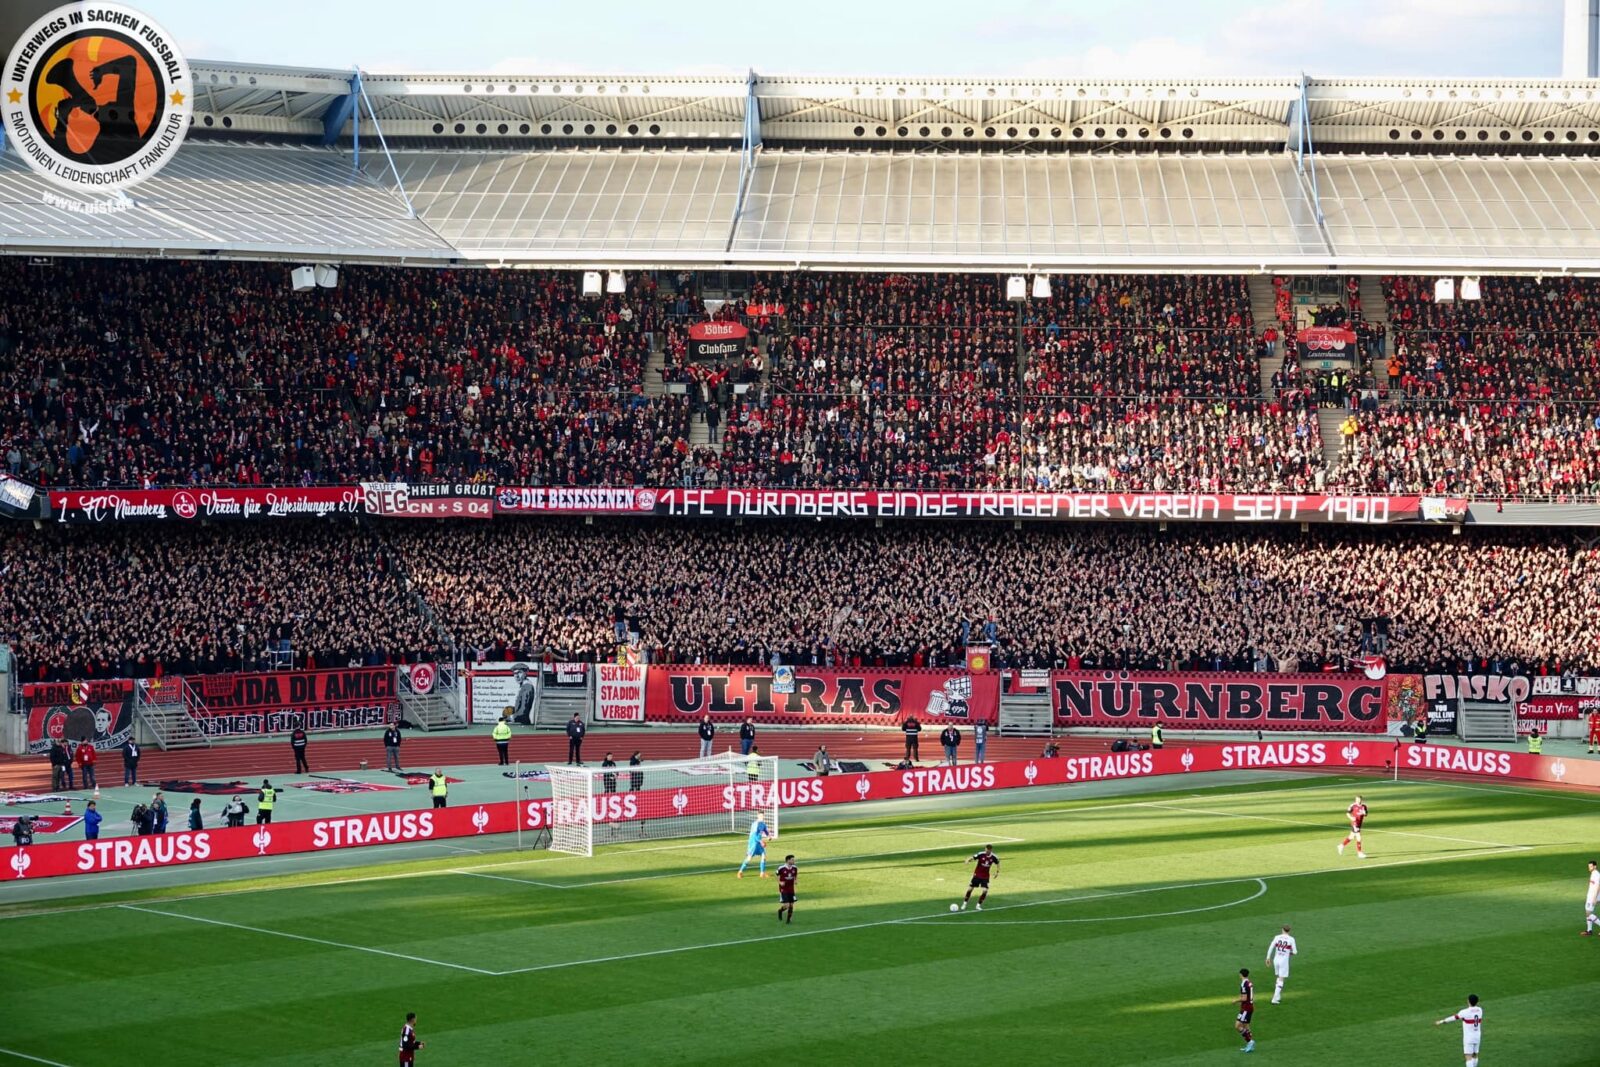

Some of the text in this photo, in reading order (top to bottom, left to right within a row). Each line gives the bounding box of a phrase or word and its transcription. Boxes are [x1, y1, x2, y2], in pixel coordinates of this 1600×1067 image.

[176, 503, 195, 513] FCN
[200, 491, 241, 516] Verein
[244, 497, 261, 518] für
[266, 493, 335, 516] Leibesübungen
[365, 490, 408, 514] SIEG
[453, 502, 462, 512] S
[468, 502, 489, 514] 04
[521, 488, 635, 509] DIE BESESSENEN
[726, 490, 869, 516] NÜRNBERG
[1119, 495, 1219, 519] VEREIN
[1233, 495, 1306, 521] SEIT
[1318, 496, 1389, 523] 1900
[289, 675, 316, 702] DI
[325, 669, 396, 700] AMICI
[415, 677, 430, 686] FCN
[600, 666, 641, 681] SEKTION
[601, 686, 640, 700] STADION
[669, 675, 902, 716] ULTRAS
[1055, 671, 1384, 722] NÜRNBERG
[1424, 674, 1530, 702] FIASKO
[601, 705, 640, 719] VERBOT
[1555, 702, 1574, 715] VITA
[1066, 753, 1153, 780] STRAUSS
[1221, 743, 1326, 767] STRAUSS
[1407, 745, 1511, 774] STRAUSS
[902, 765, 995, 795] STRAUSS
[722, 779, 823, 810] STRAUSS
[527, 794, 637, 826] STRAUSS
[313, 812, 433, 847] STRAUSS
[77, 832, 211, 870] STRAUSS
[1277, 940, 1288, 952] 22
